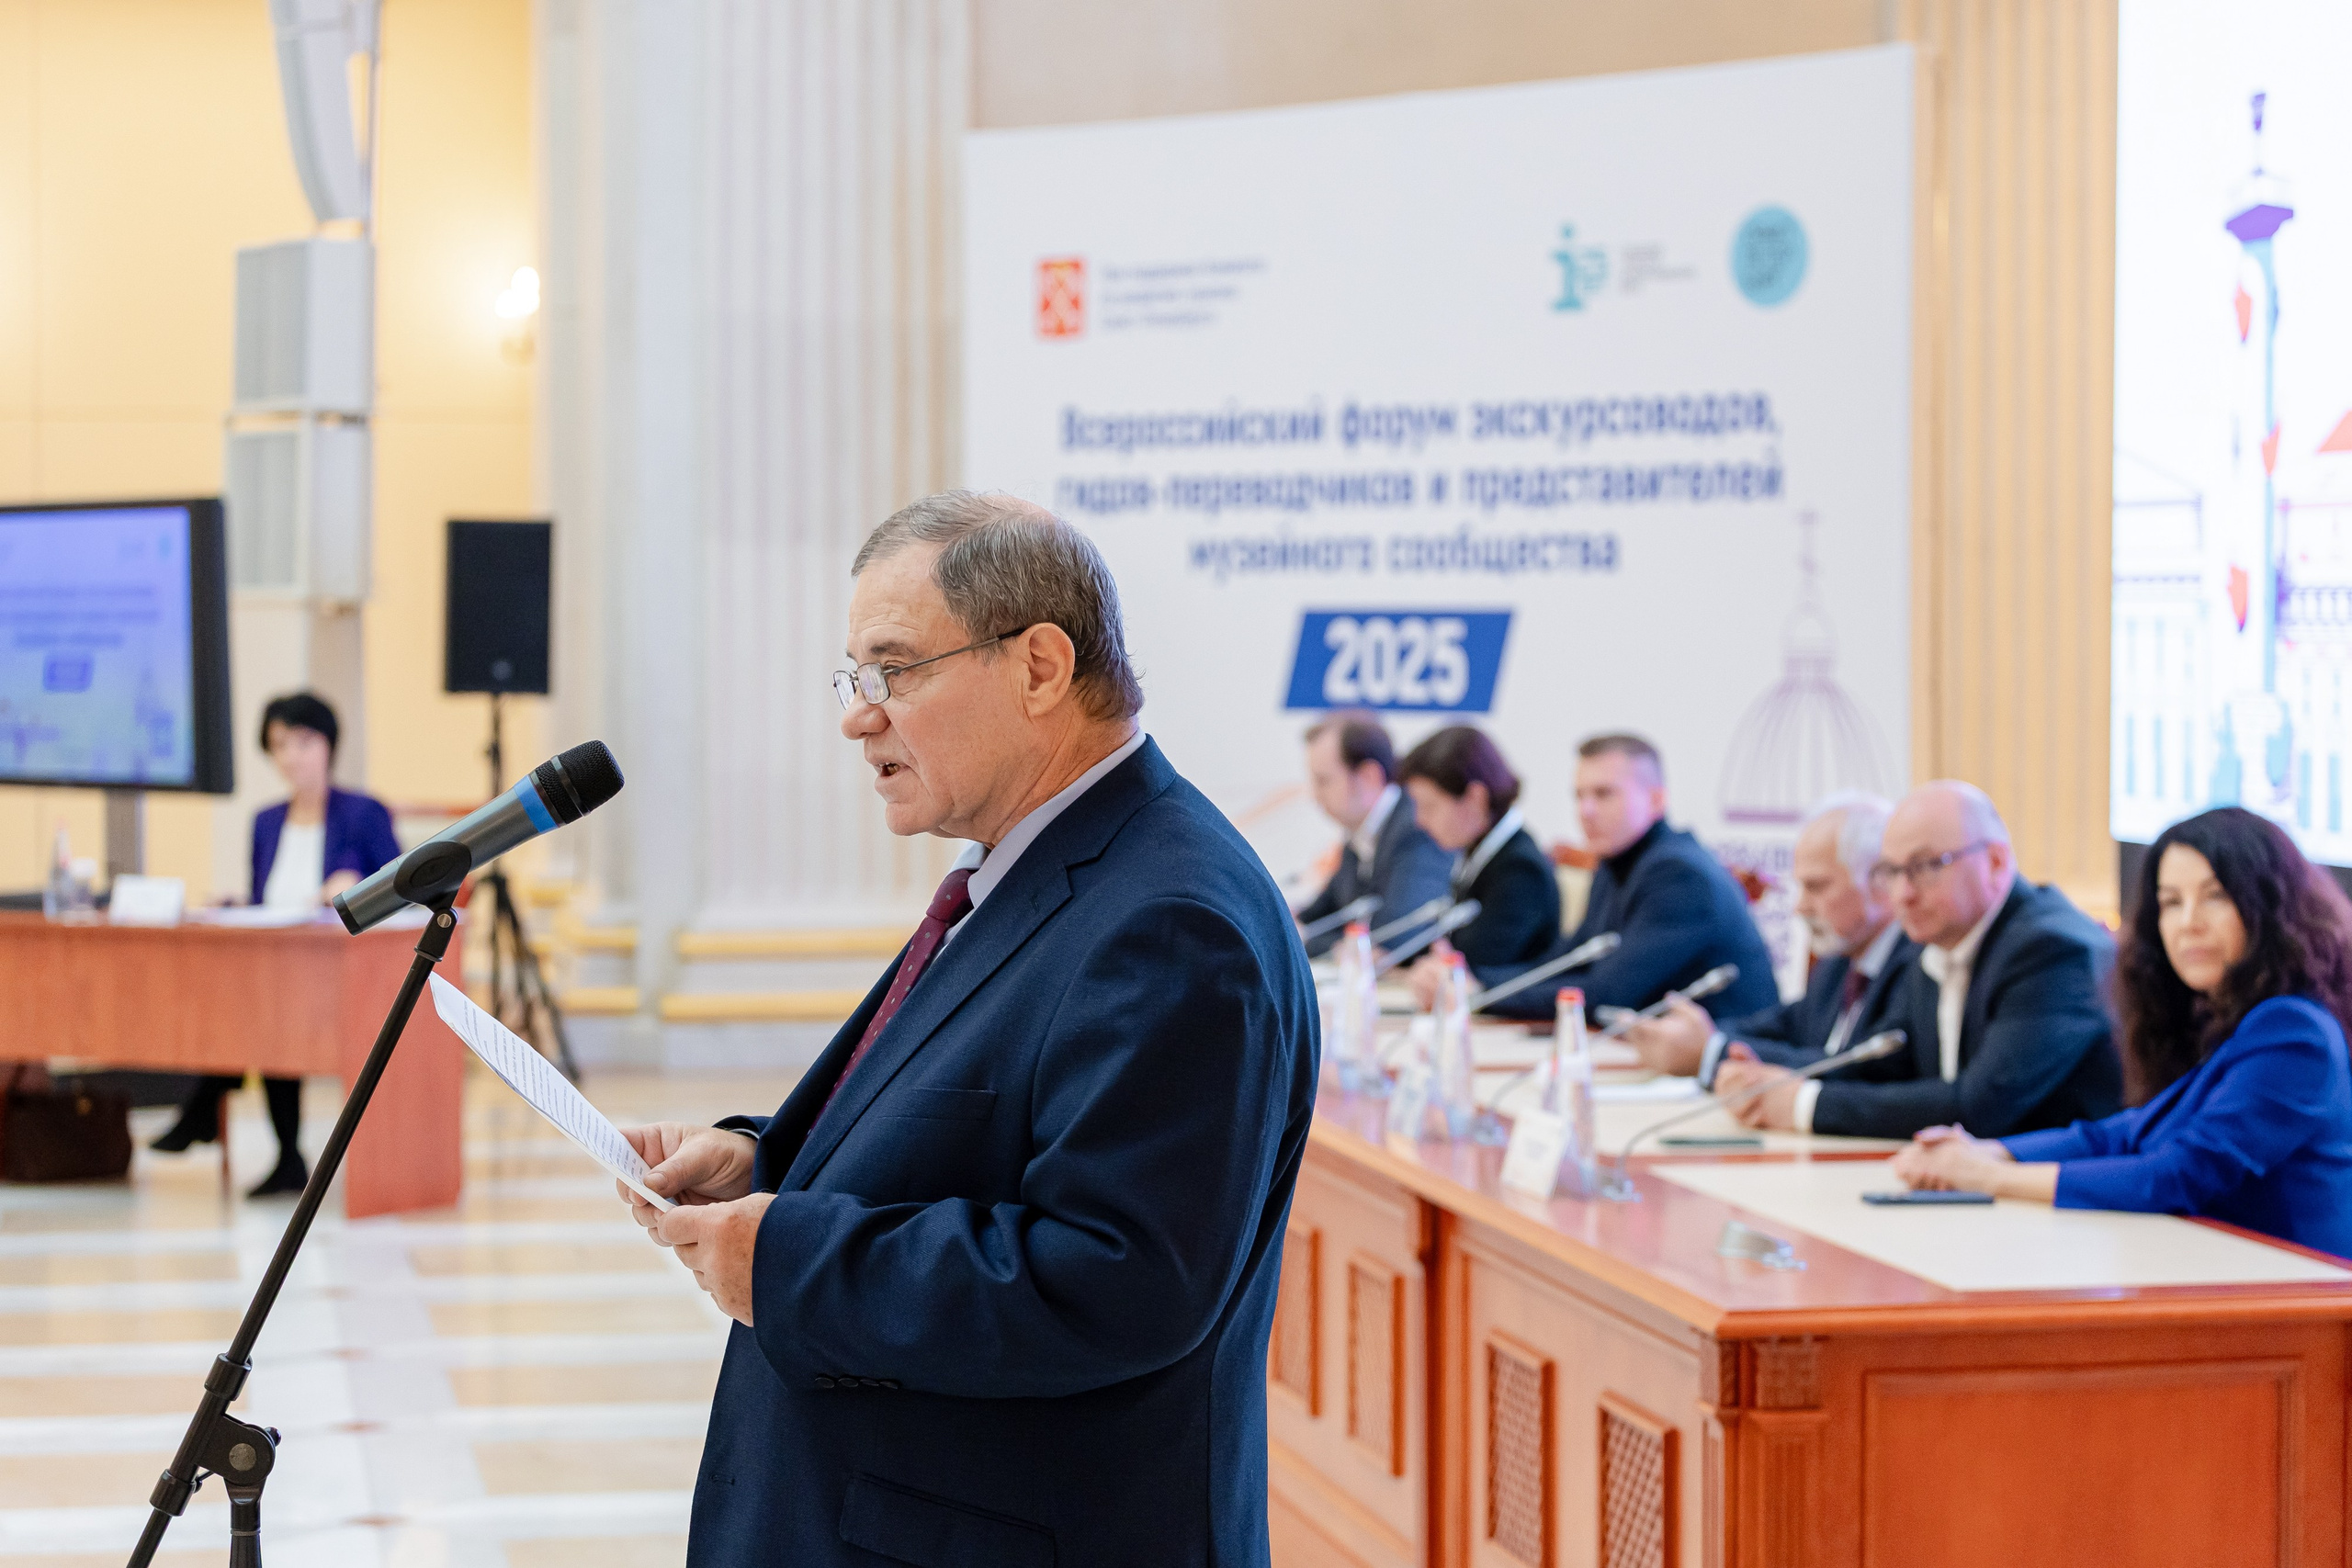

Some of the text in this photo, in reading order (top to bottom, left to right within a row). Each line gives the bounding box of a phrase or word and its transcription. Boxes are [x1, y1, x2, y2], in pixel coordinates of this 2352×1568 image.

[1063, 390, 1781, 454] Всероссийский форум экскурсоводов,
[1058, 446, 1782, 515] гидов-переводчиков и представителей
[1190, 520, 1619, 582] музейного сообщества
[1321, 615, 1471, 707] 2025
